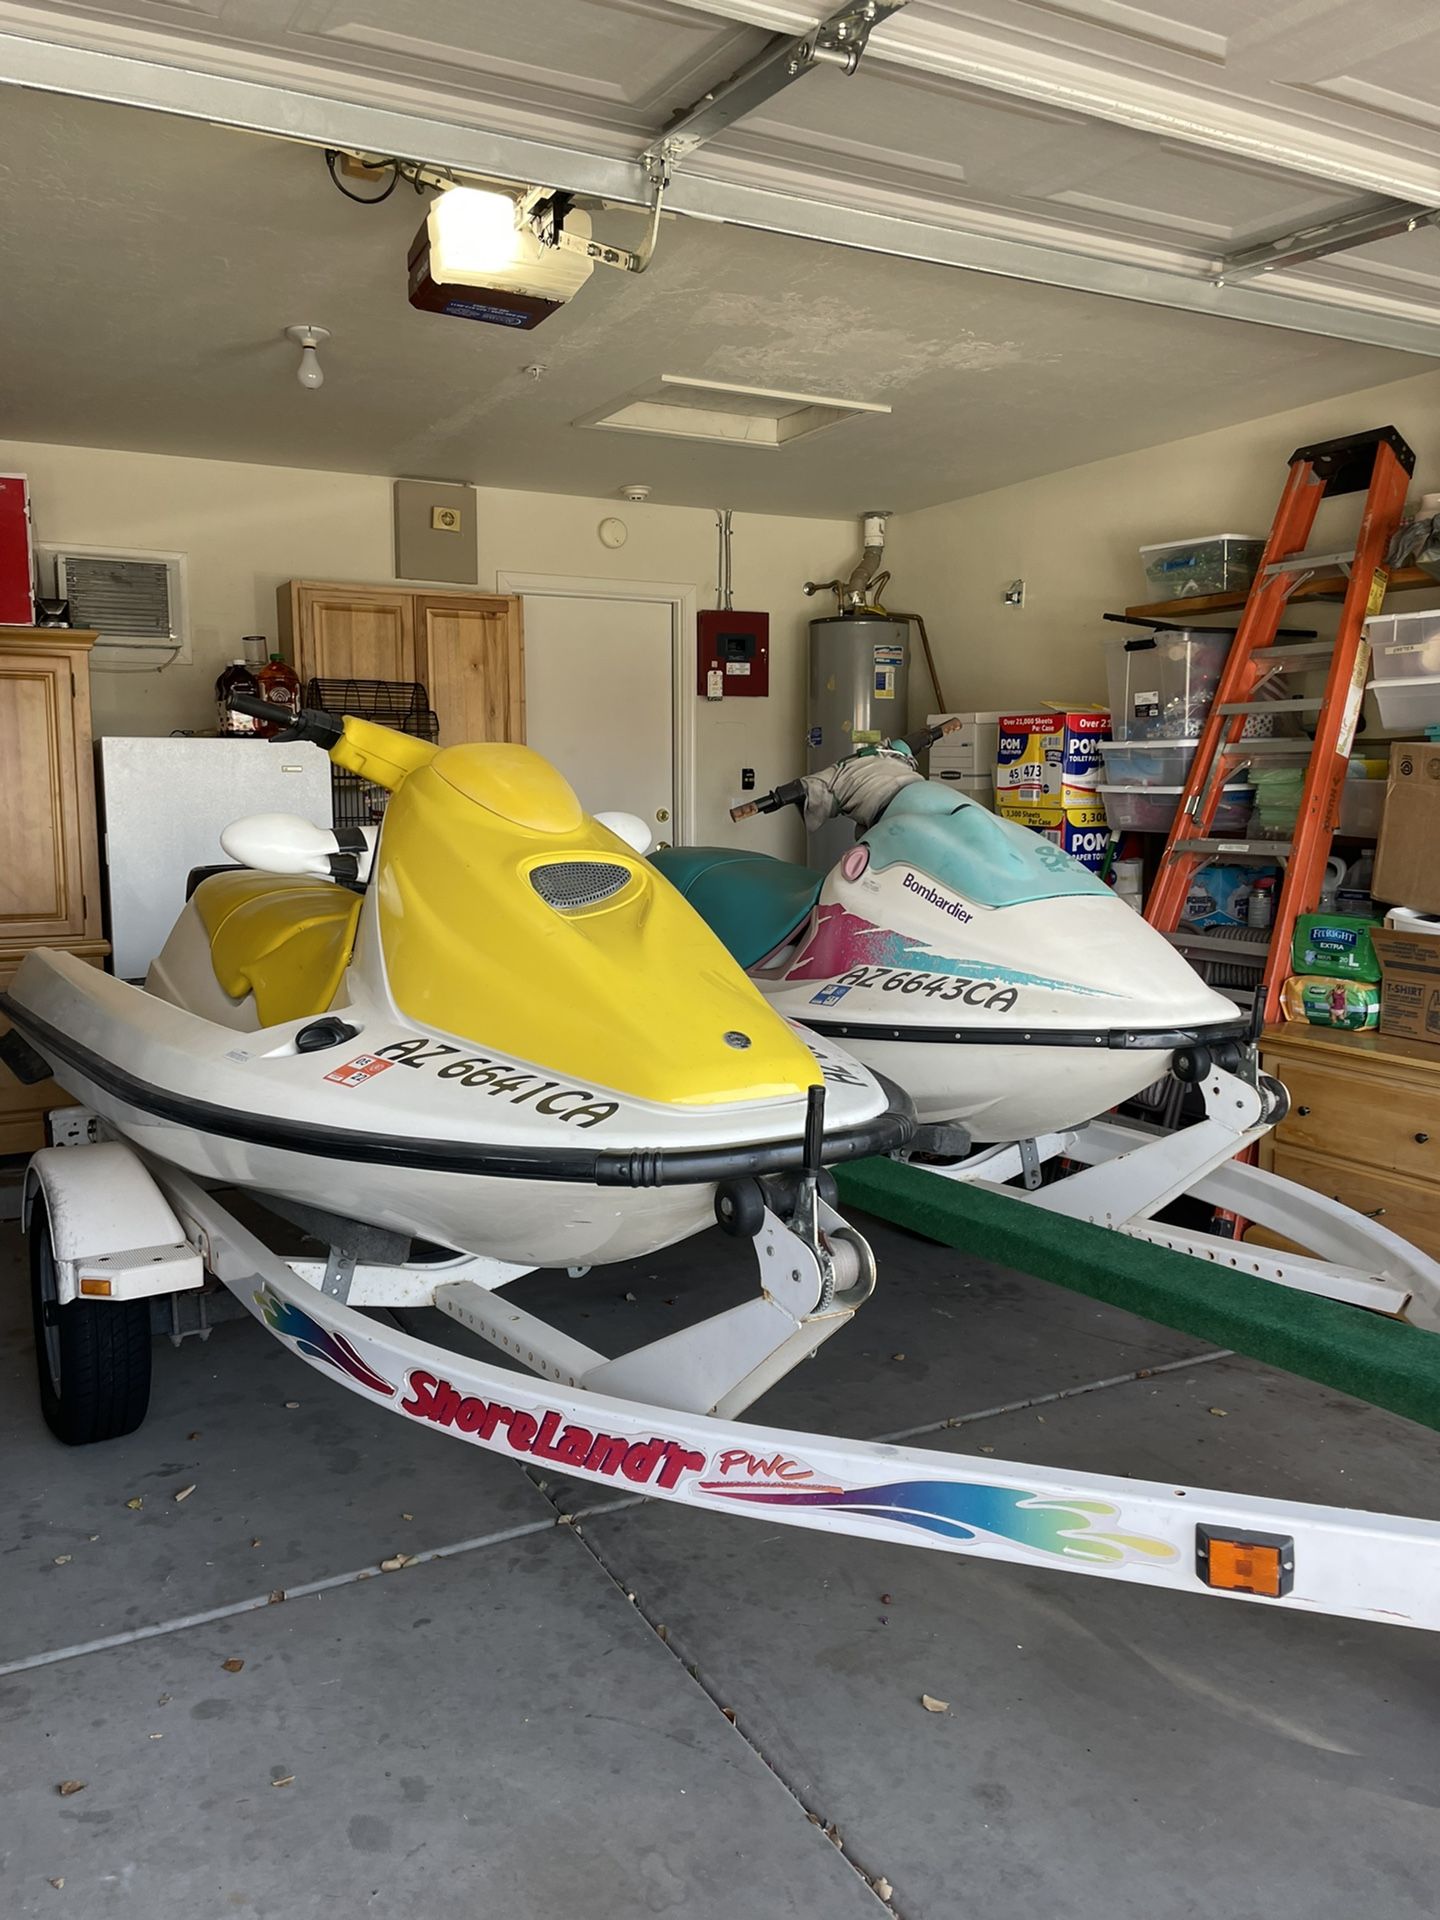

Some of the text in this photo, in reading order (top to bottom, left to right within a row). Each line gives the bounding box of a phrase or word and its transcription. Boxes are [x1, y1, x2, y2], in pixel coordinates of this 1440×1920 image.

[1015, 718, 1034, 726] 21,000
[1035, 717, 1053, 725] Sheets
[1080, 718, 1100, 728] Over
[1000, 738, 1021, 750] POM
[1009, 765, 1042, 779] 45 473
[1022, 811, 1041, 819] Sheets
[1071, 832, 1111, 853] POM
[902, 872, 974, 925] Bombardier
[1320, 942, 1345, 951] EXTRA
[1348, 953, 1360, 968] L
[1386, 983, 1424, 997] T-SHIRT
[350, 1071, 369, 1082] 22
[719, 1449, 815, 1480] PWC
